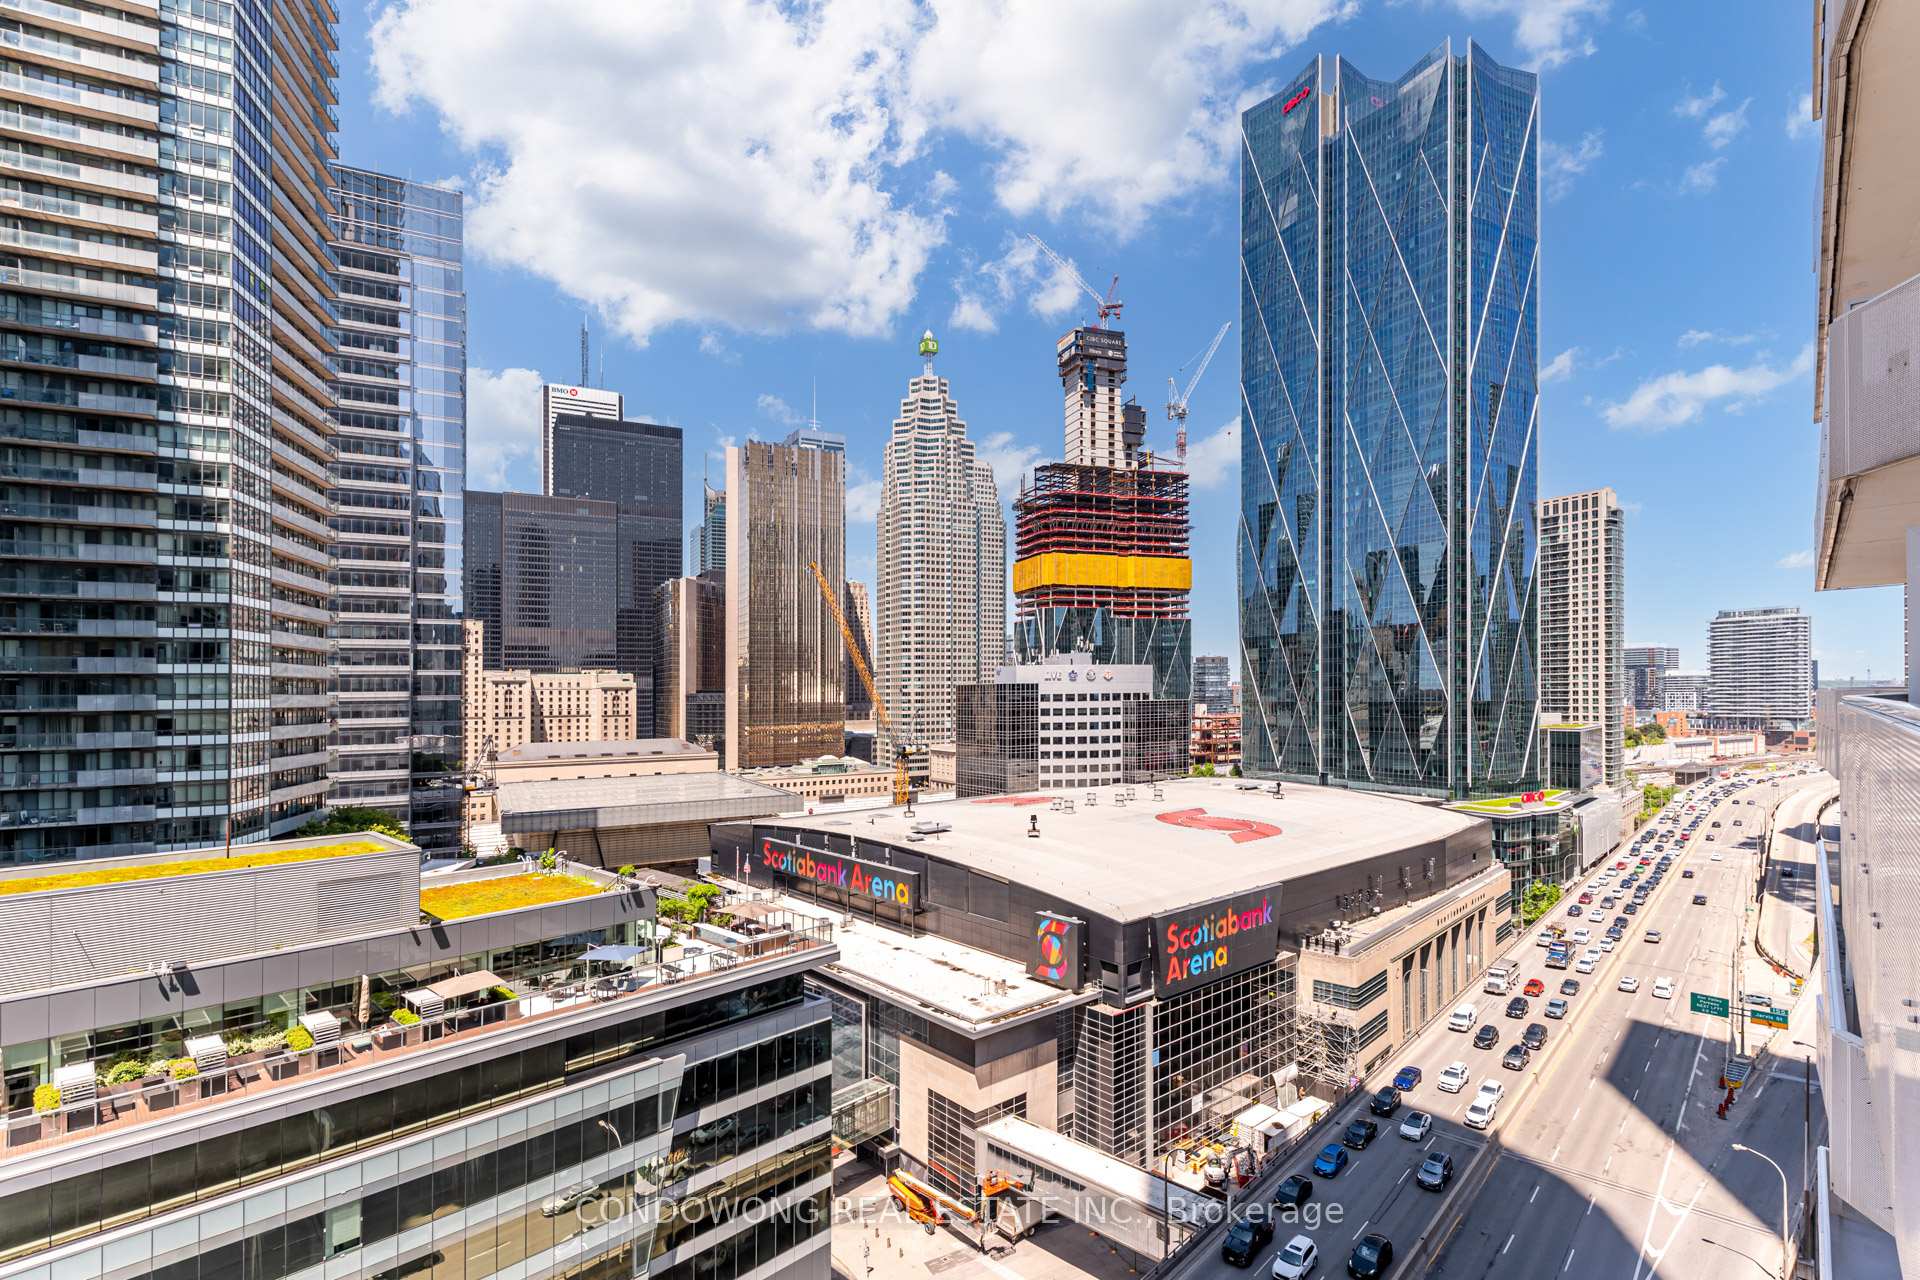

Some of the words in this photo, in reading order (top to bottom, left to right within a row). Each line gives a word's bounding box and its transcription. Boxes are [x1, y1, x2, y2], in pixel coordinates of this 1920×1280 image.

[1101, 337, 1122, 346] SQUARE
[551, 386, 569, 395] BMO
[762, 839, 848, 888] Scotiabank
[850, 862, 910, 906] Arena
[1166, 895, 1273, 955] Scotiabank
[1165, 945, 1228, 985] Arena
[1755, 1012, 1774, 1021] Jarvis
